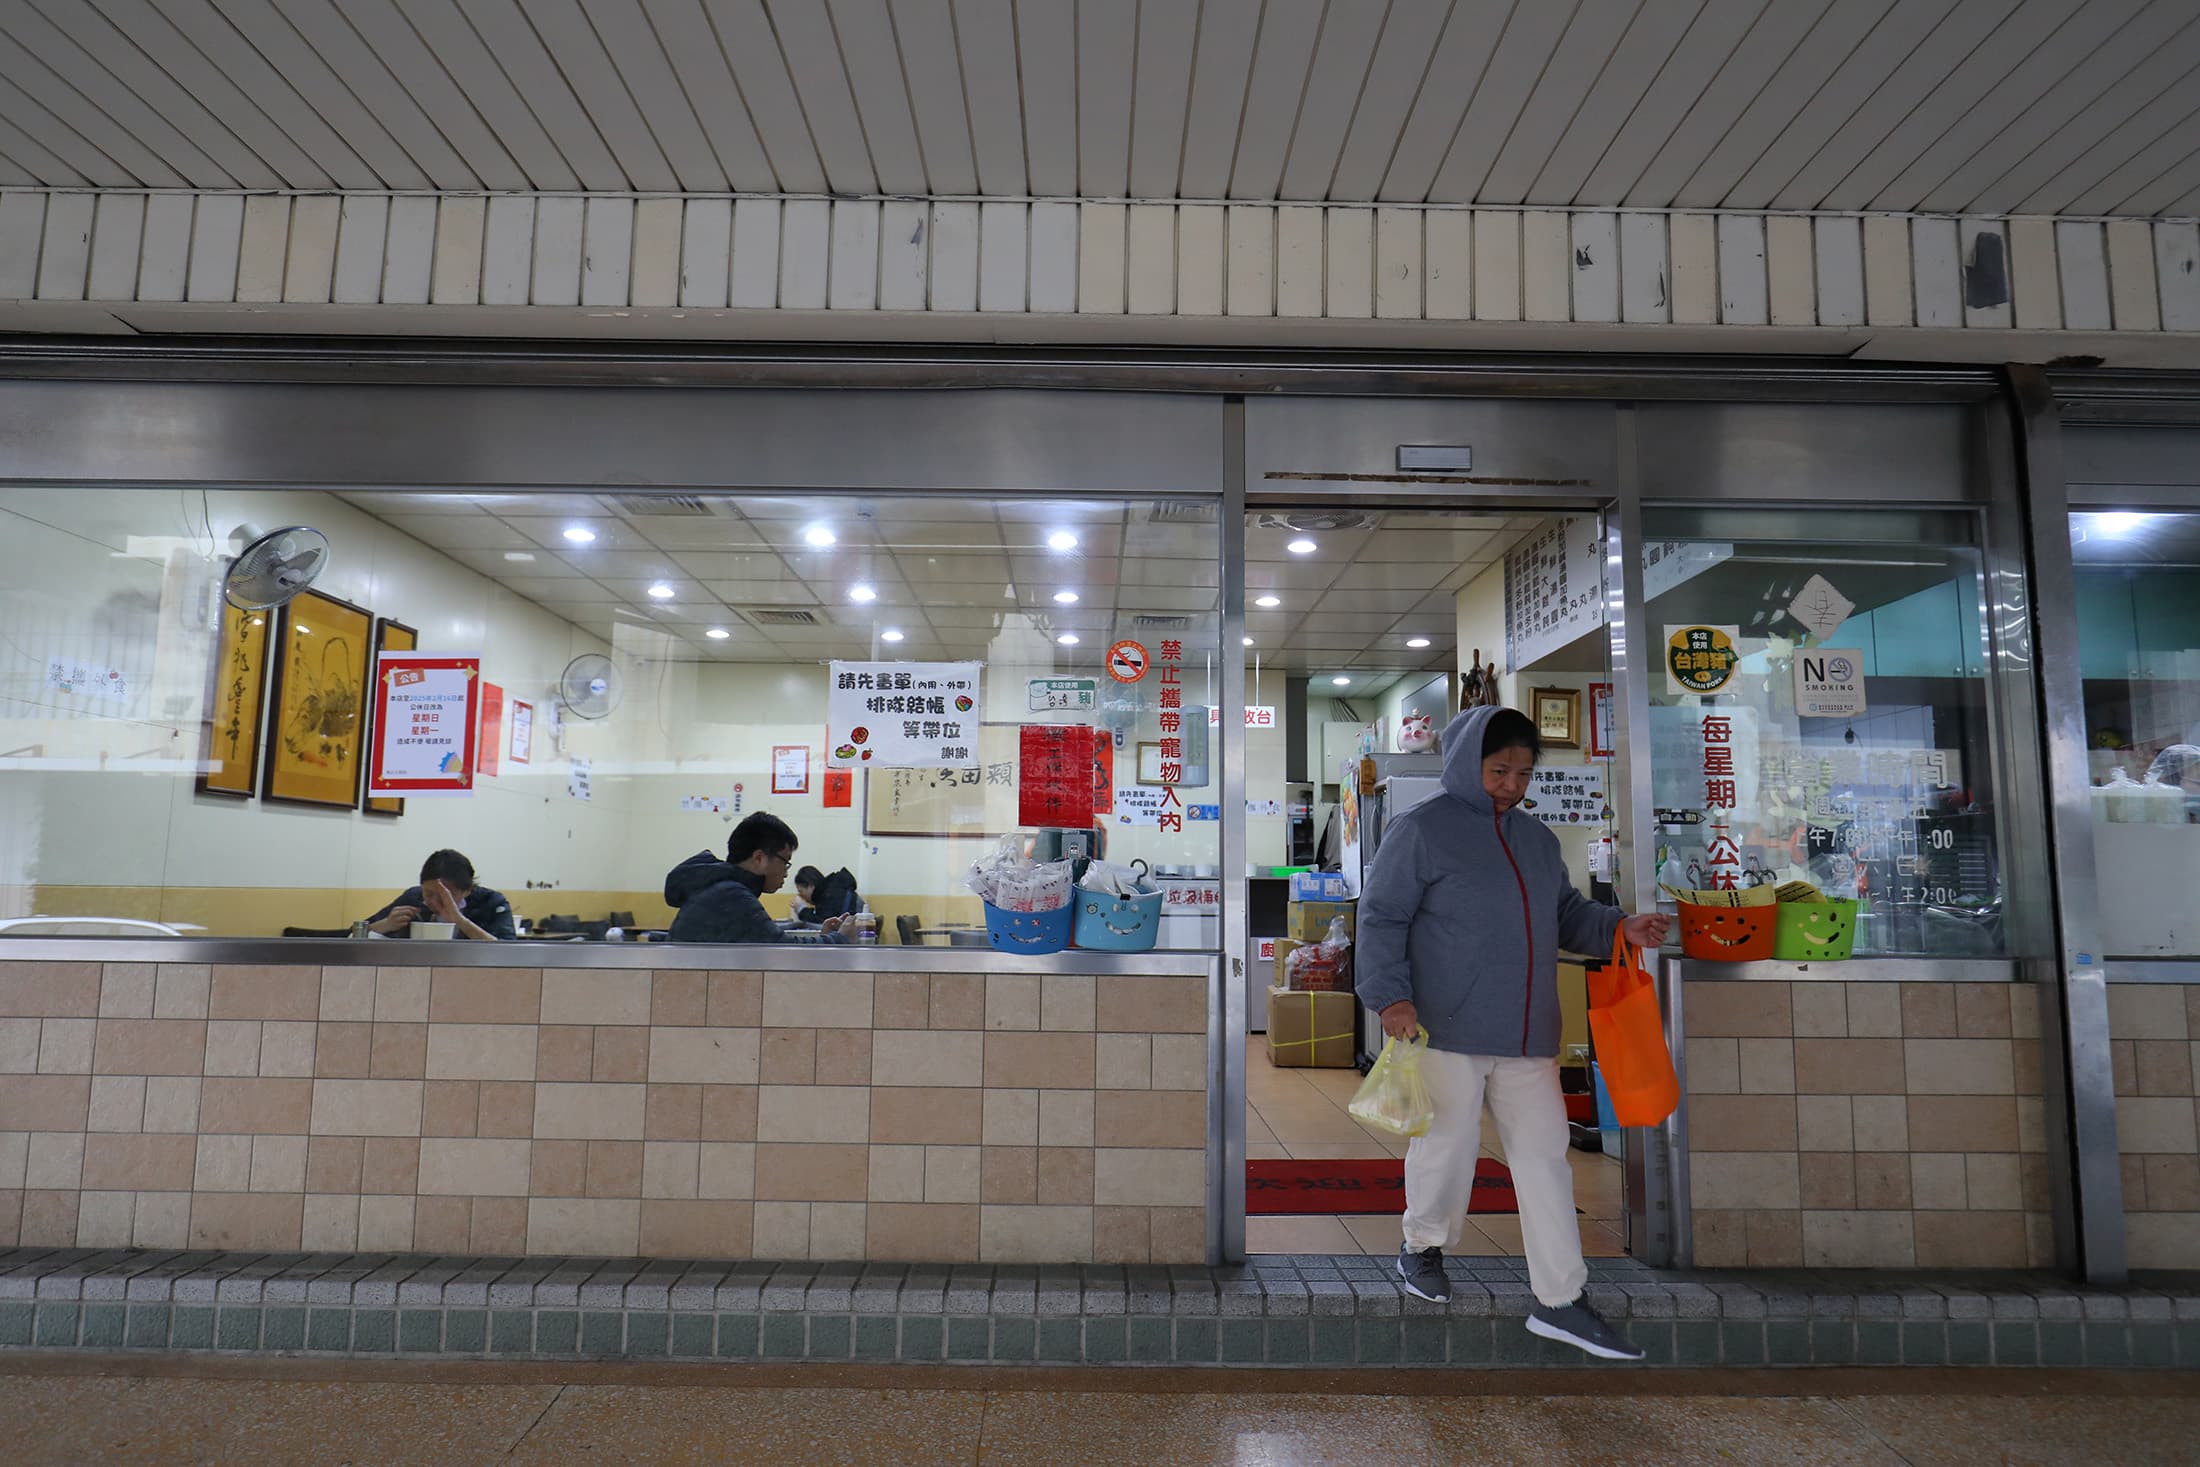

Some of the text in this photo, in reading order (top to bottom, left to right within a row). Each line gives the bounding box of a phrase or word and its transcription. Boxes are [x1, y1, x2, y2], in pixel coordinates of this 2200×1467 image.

[1674, 652, 1728, 671] 台灣豬
[1681, 675, 1707, 690] TAIWAN
[1805, 684, 1855, 692] SMOKING
[866, 695, 945, 714] 排隊結帳
[411, 713, 439, 722] 星期日
[411, 726, 439, 735] 星期一
